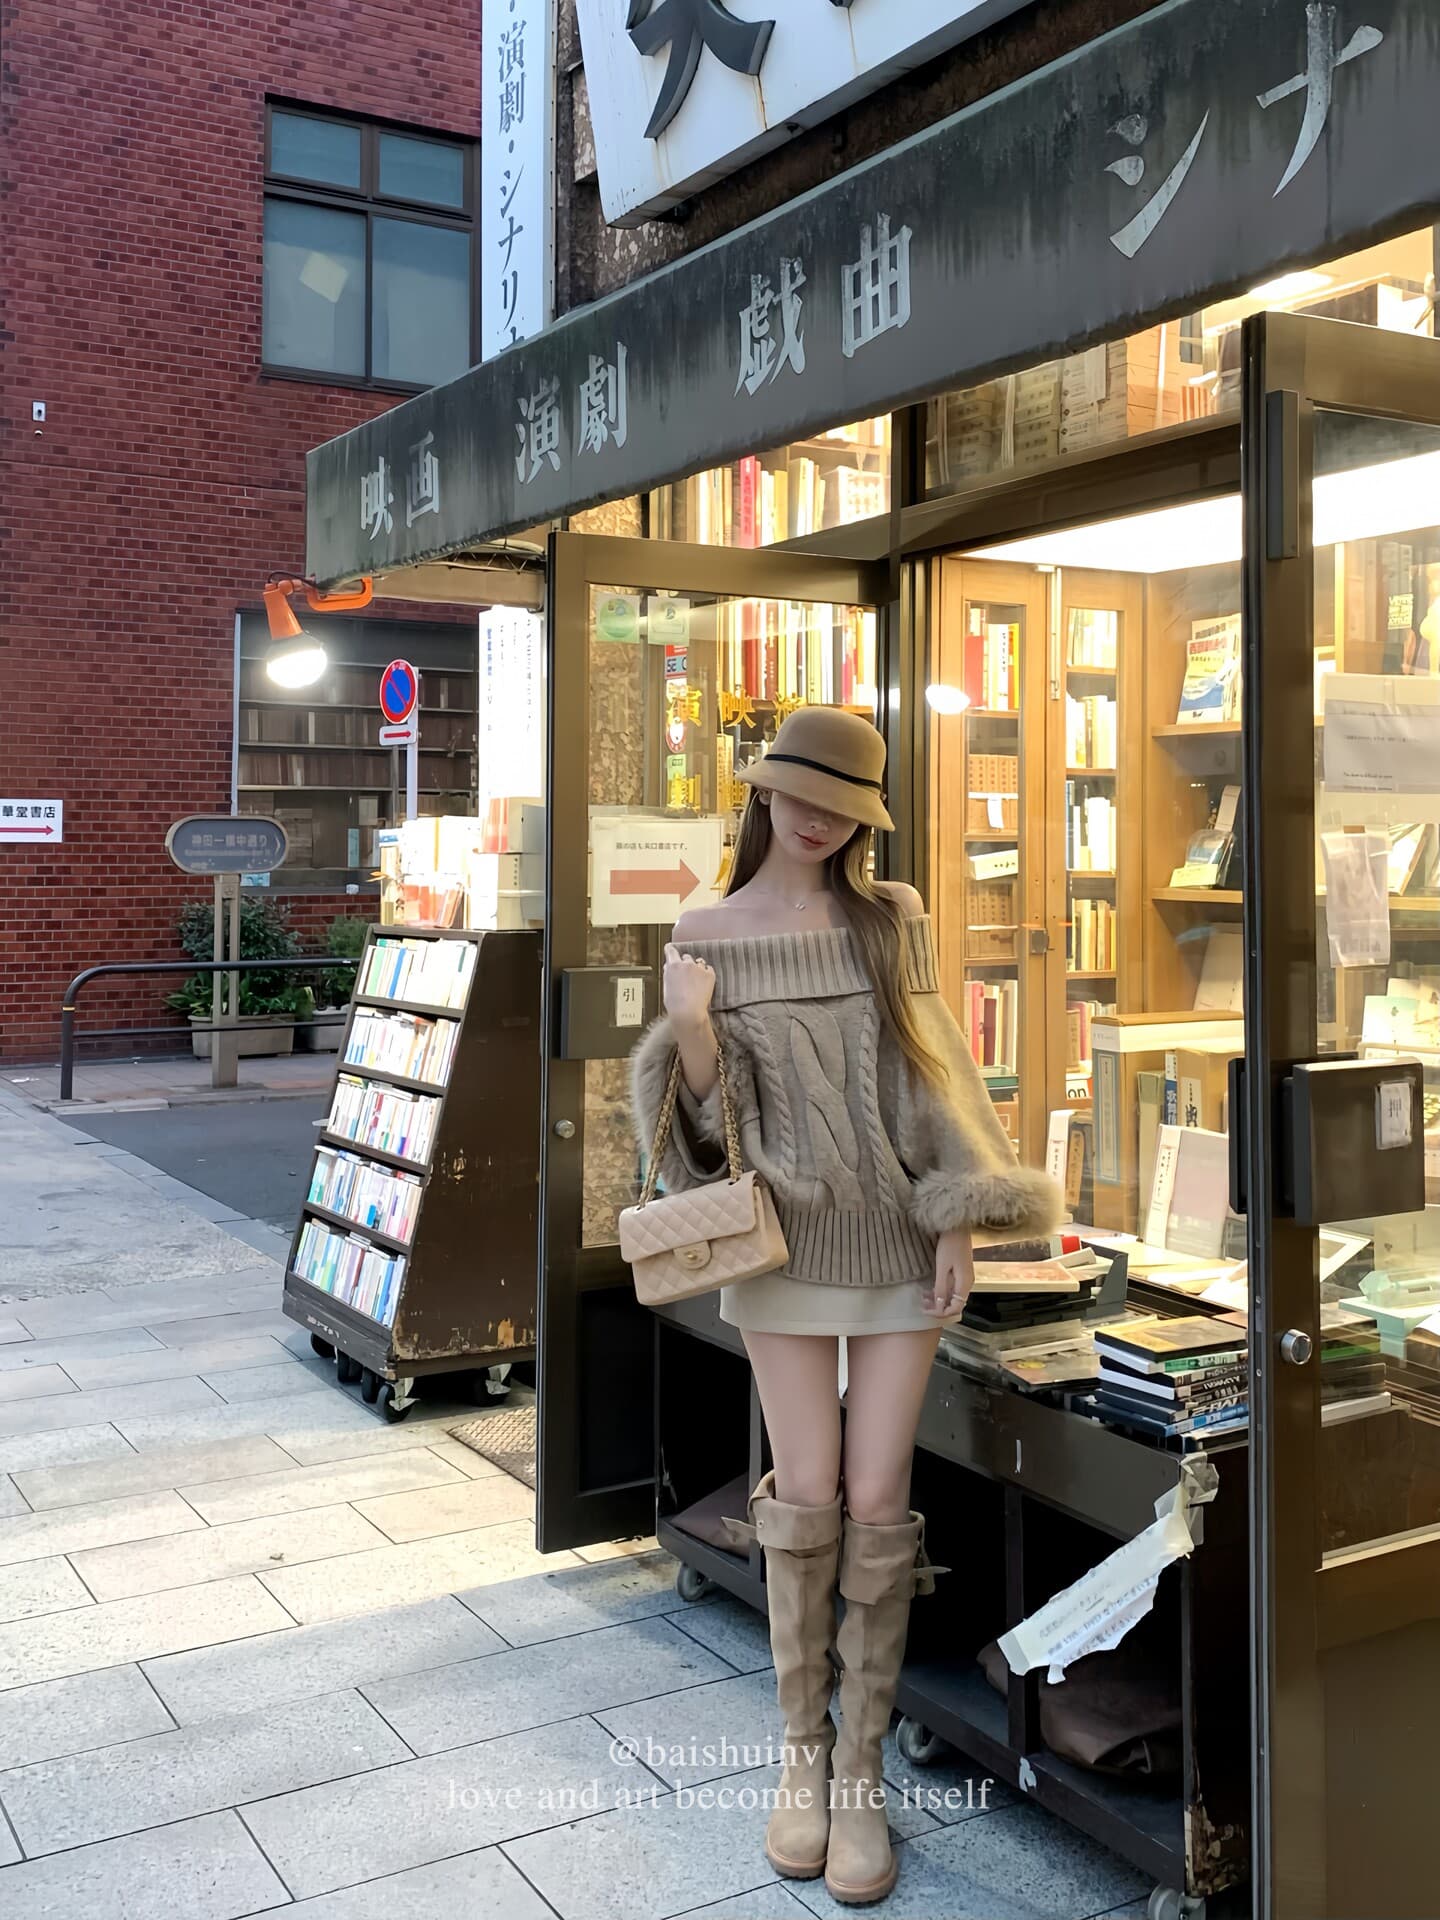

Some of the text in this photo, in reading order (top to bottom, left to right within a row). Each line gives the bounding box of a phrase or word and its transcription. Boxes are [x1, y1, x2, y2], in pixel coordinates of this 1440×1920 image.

[361, 3, 1384, 541] 映画 演劇 戯曲 シナ
[623, 987, 635, 1002] 引
